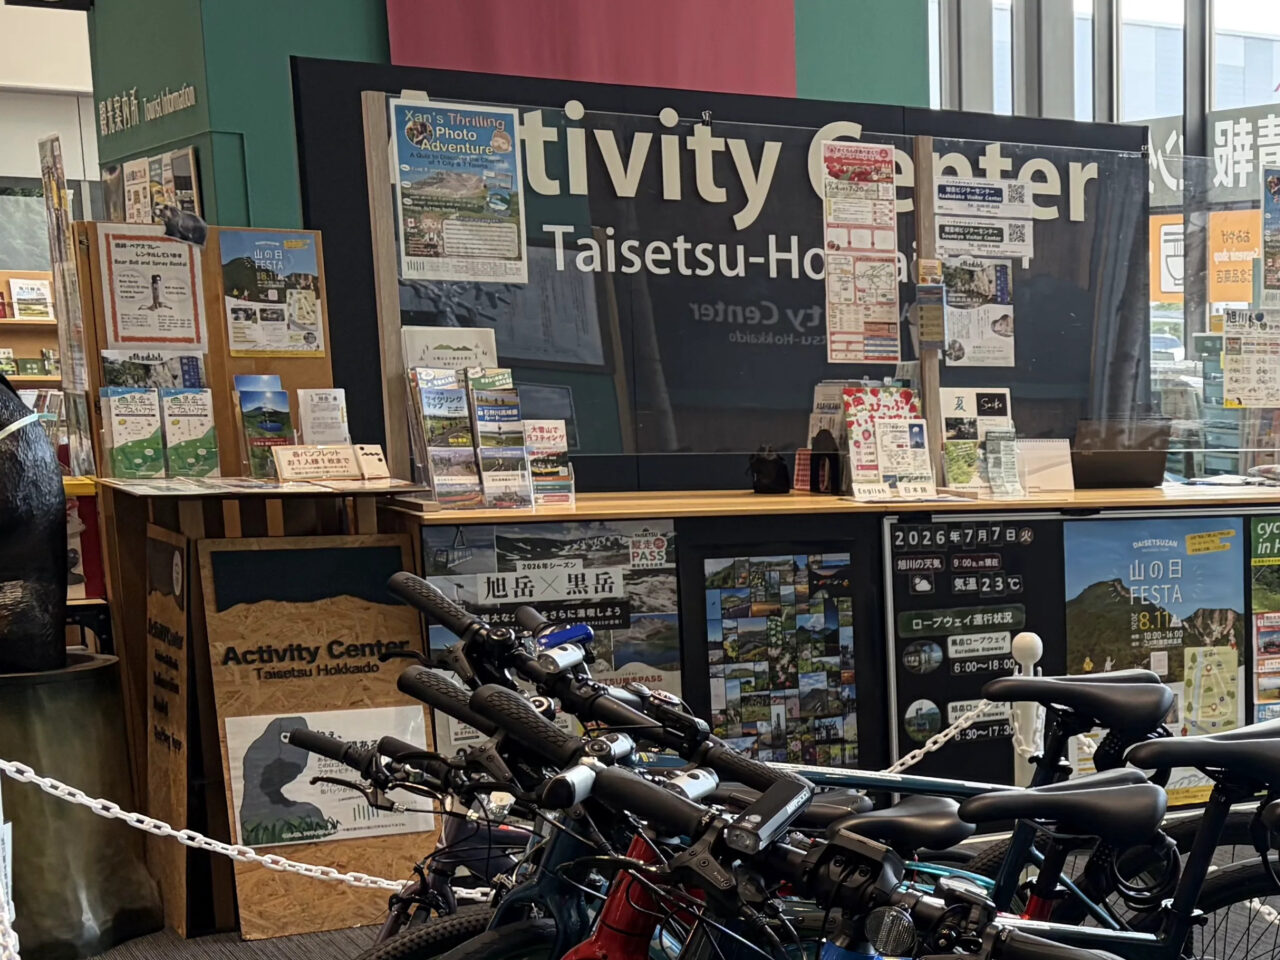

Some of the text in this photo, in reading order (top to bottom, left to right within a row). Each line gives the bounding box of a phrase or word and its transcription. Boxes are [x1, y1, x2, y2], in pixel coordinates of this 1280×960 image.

[405, 110, 506, 132] Xan's Thrilling
[435, 127, 477, 141] Photo
[421, 140, 494, 155] Adventure
[520, 99, 782, 230] tivity
[254, 249, 283, 259] 山の日
[255, 261, 284, 270] FESTA
[424, 394, 463, 404] サイクリング
[954, 396, 967, 412] 夏
[425, 402, 444, 410] マップ
[531, 426, 560, 434] 大雪山で
[292, 450, 341, 458] 各パンフレット
[857, 487, 887, 495] English
[904, 486, 928, 494] 日本語
[1132, 538, 1178, 549] DAISETSUZAN
[1257, 538, 1271, 554] in
[632, 550, 664, 561] PASS
[522, 562, 577, 570] 2026年シーズン
[897, 558, 942, 569] 旭川の天気
[1130, 559, 1182, 581] 山の日
[1130, 584, 1183, 605] FESTA
[912, 612, 1014, 630] ロープウェイ運行状況
[1140, 611, 1170, 630] 8.11
[951, 634, 1007, 647] 黒岳ロープウェイ
[222, 643, 319, 666] Activity
[253, 661, 380, 681] Taisetsu Hokkaido
